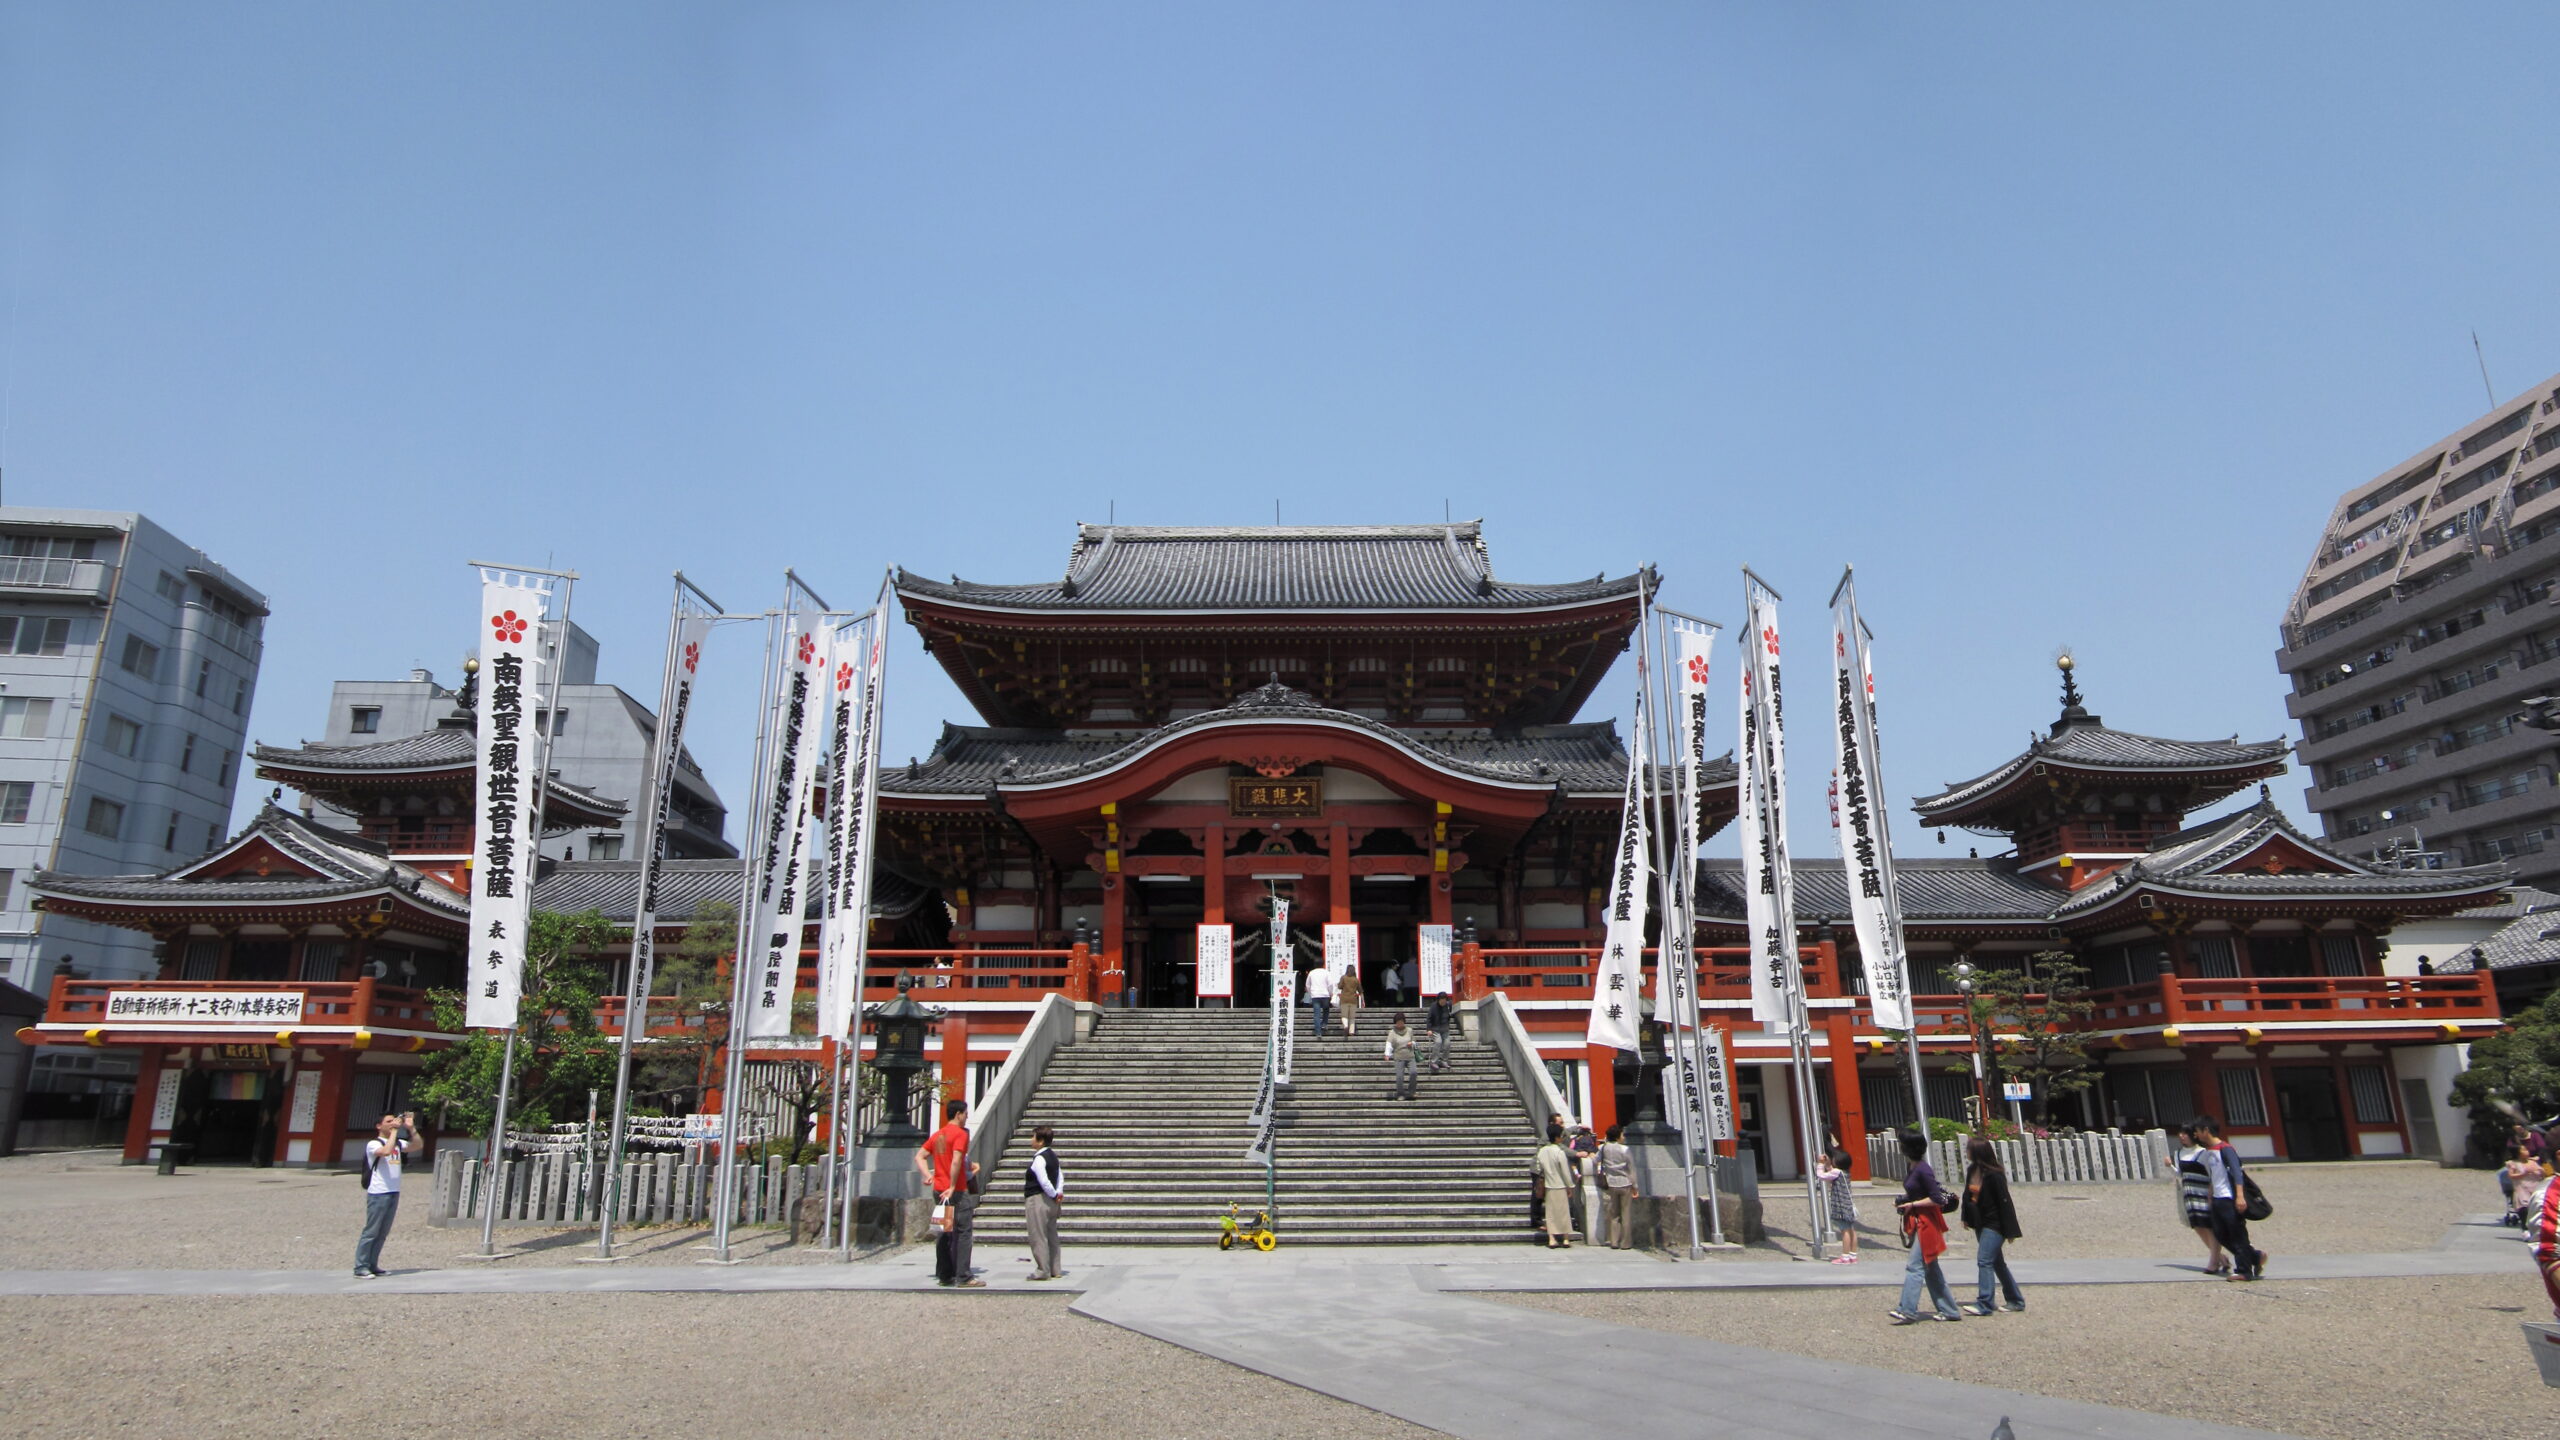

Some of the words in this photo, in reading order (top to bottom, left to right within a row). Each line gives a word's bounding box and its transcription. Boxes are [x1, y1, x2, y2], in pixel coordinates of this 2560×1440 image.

[485, 652, 523, 899] 南無聖観世音菩薩
[1250, 787, 1309, 806] 大悲殿
[1837, 668, 1884, 899] 南無聖観世音菩薩
[484, 920, 506, 999] 表参道
[1607, 943, 1625, 1021] 林雲華
[1705, 1044, 1725, 1107] 如意輪観音
